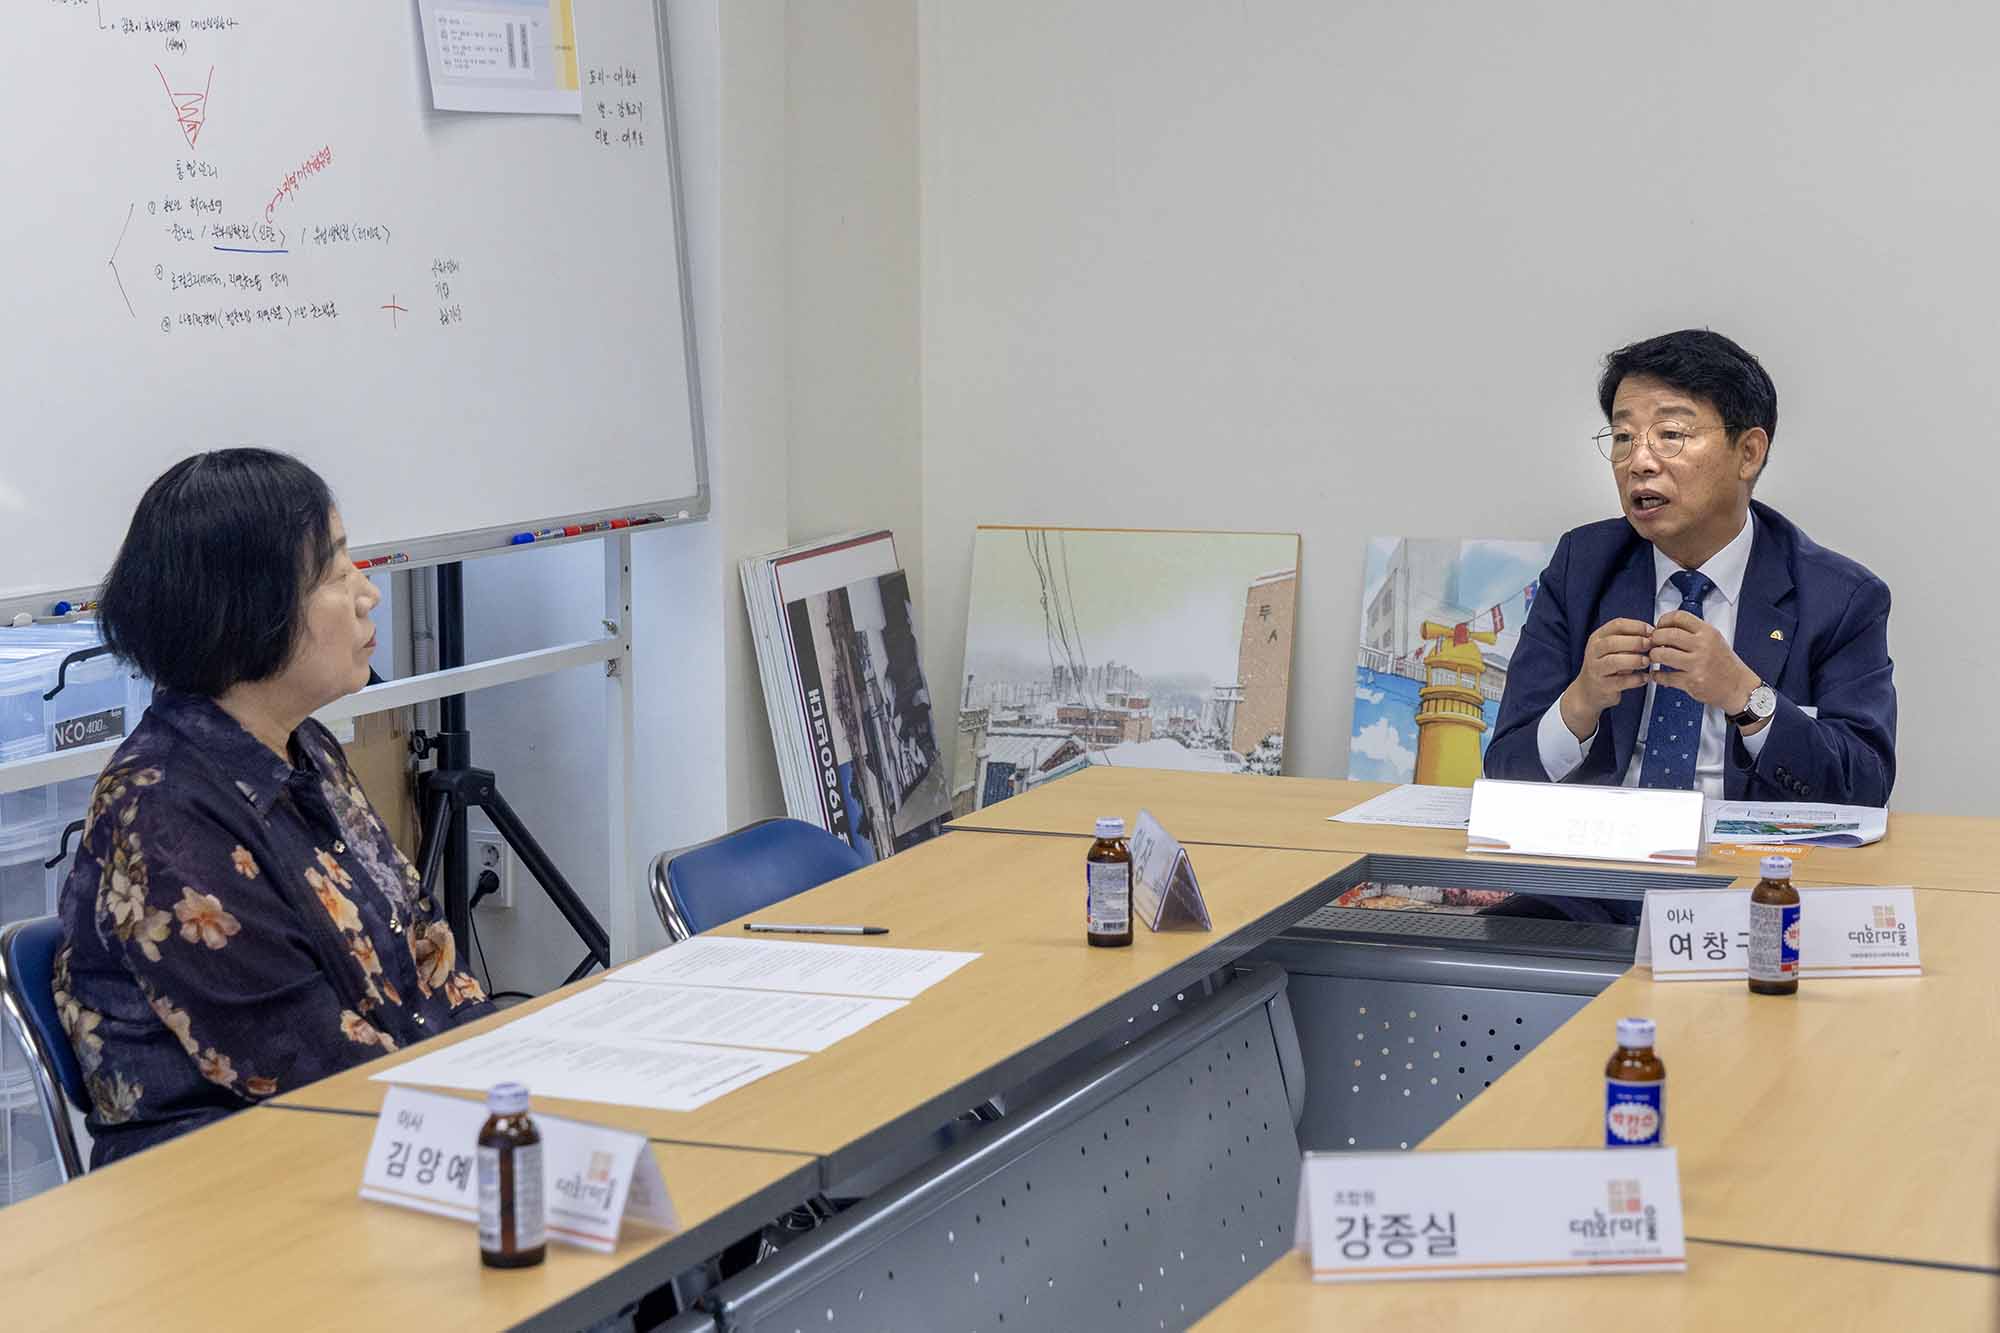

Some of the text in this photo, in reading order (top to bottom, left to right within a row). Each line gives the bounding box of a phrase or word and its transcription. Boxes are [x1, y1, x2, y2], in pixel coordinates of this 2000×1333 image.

[86, 719, 104, 734] 400
[806, 687, 846, 826] 1980년대
[1667, 908, 1695, 925] 이사
[1848, 923, 1908, 946] 대화마을
[397, 1109, 423, 1130] 이사
[386, 1141, 475, 1191] 김양예
[1336, 1212, 1458, 1261] 강종실
[1569, 1205, 1657, 1242] 대화마을
